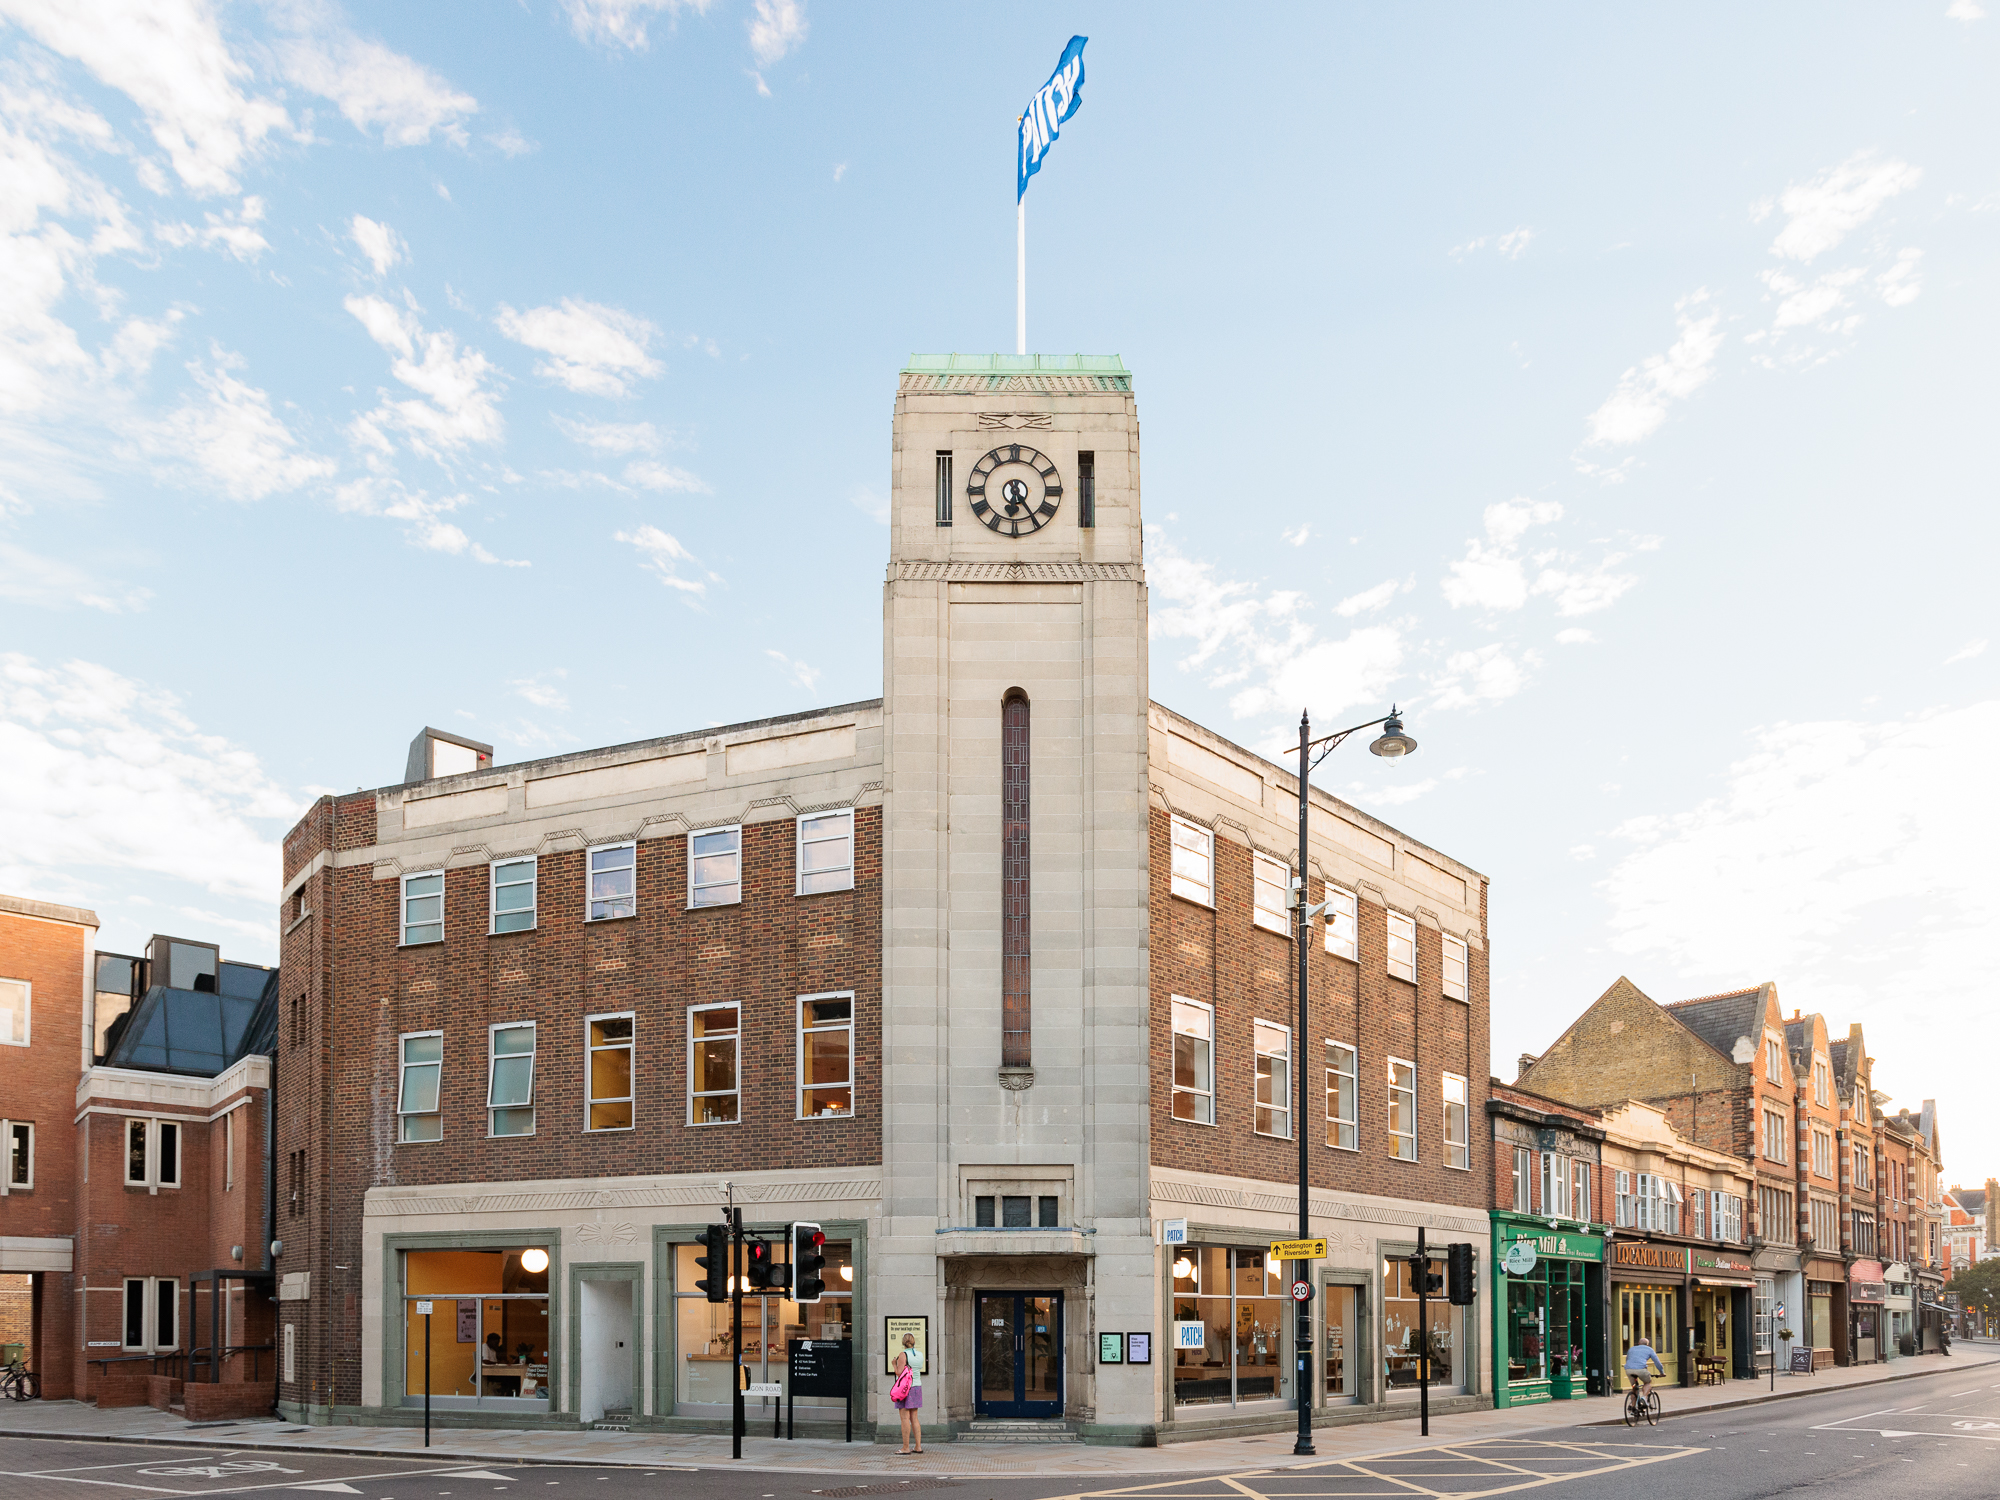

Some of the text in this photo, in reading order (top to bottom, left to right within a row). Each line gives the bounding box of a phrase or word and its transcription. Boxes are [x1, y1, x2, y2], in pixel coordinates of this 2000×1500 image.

[1022, 54, 1080, 178] PATCH
[1167, 1230, 1183, 1241] PATCH
[1538, 1236, 1557, 1253] Mill
[1616, 1245, 1685, 1268] LOCANDA LUNA
[1294, 1287, 1307, 1295] 20
[1182, 1327, 1202, 1345] PATCH
